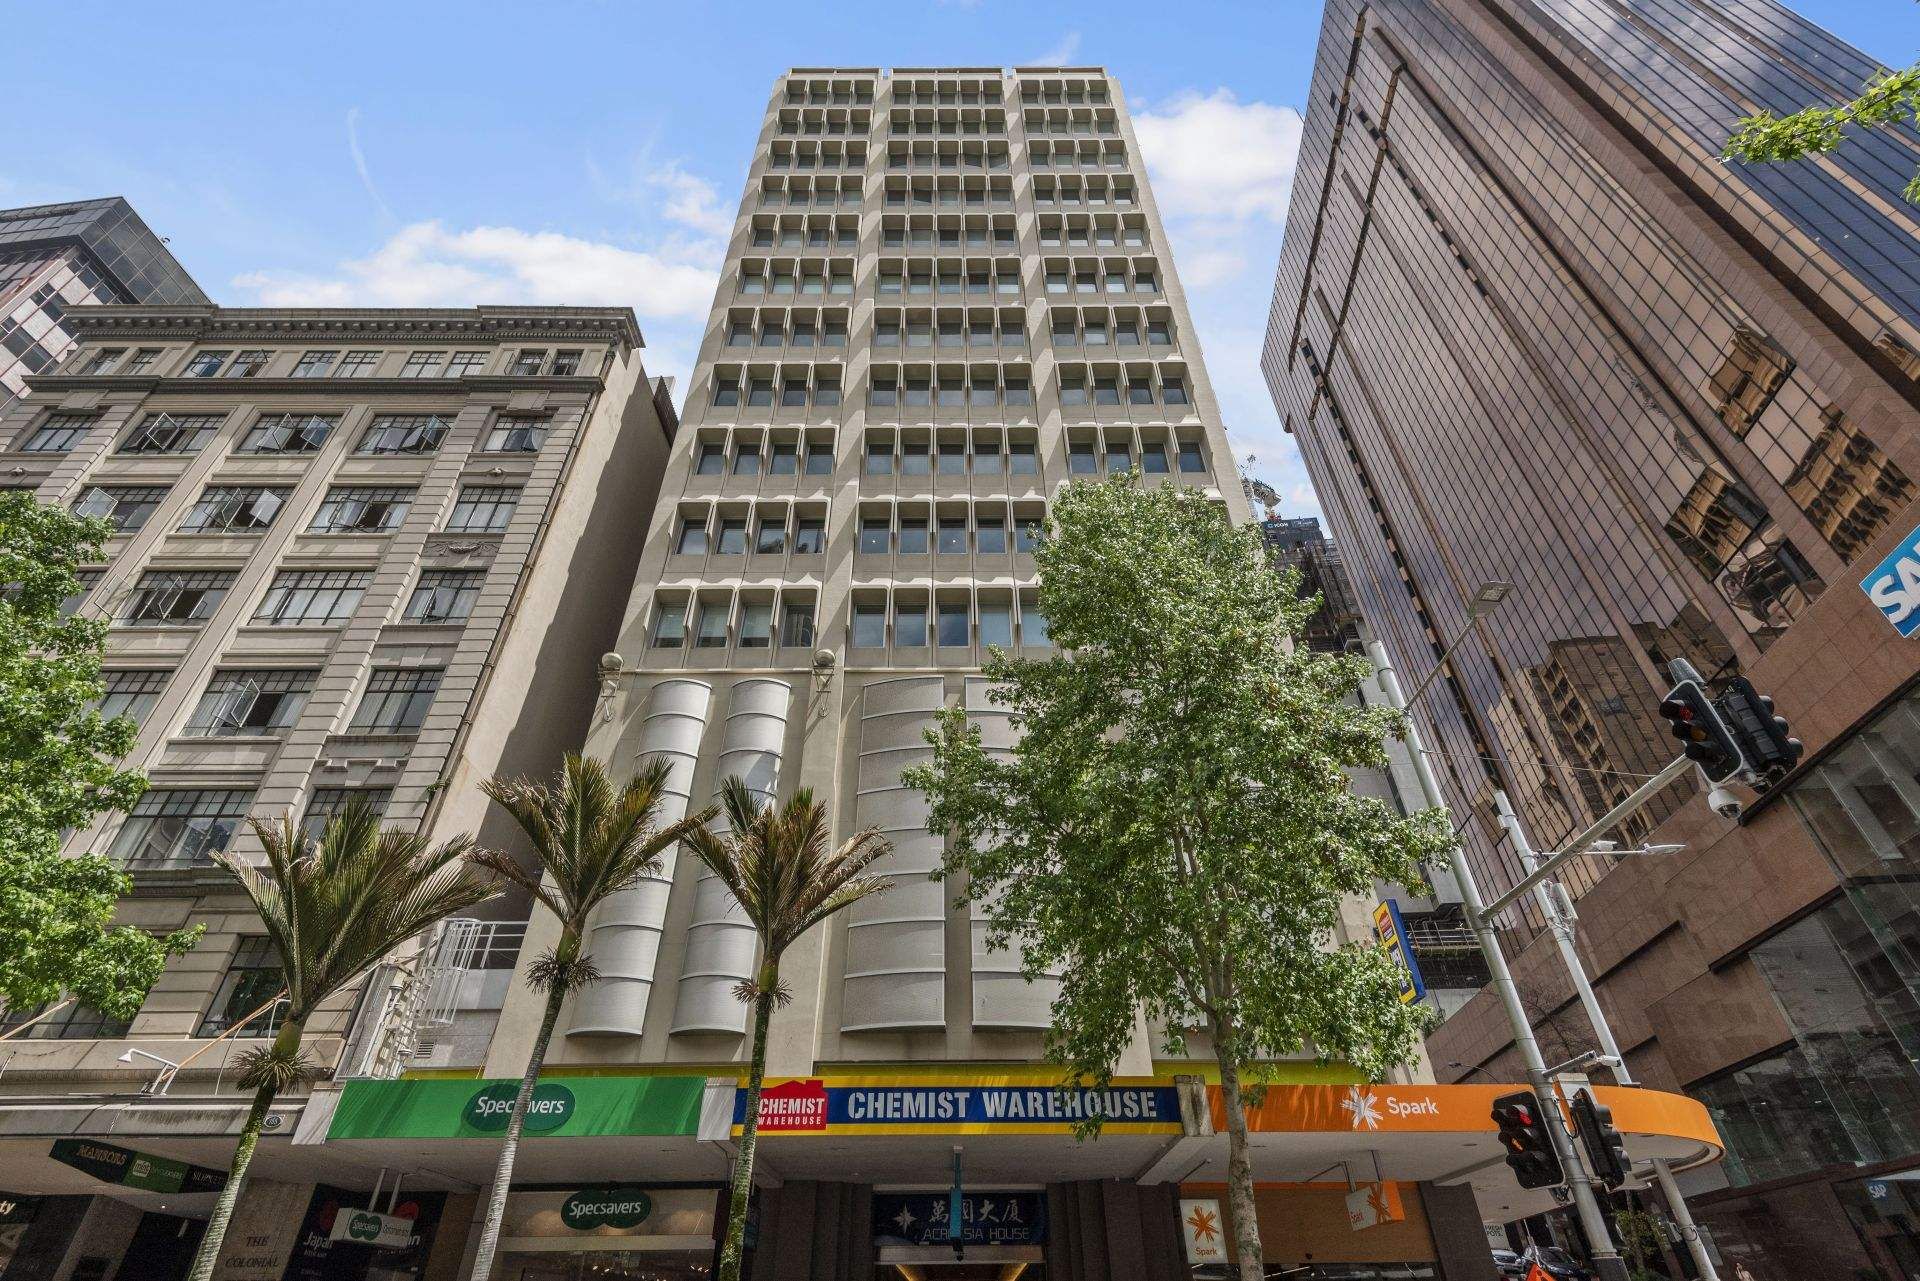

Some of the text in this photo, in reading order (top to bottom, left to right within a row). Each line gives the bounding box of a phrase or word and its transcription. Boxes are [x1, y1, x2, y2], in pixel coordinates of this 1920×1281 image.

[1869, 541, 1920, 624] SA
[475, 1096, 565, 1117] Specvers
[759, 1098, 825, 1115] CHEMIST
[848, 1091, 1157, 1118] CHEMIST WAREHOUSE
[1386, 1096, 1440, 1119] Spark
[758, 1117, 822, 1125] WAREHOUSE
[569, 1201, 641, 1218] Specsavers
[246, 1235, 270, 1248] THE
[990, 1227, 1031, 1240] HOUSE
[1195, 1247, 1218, 1256] Spark
[225, 1256, 280, 1268] COLONIAL
